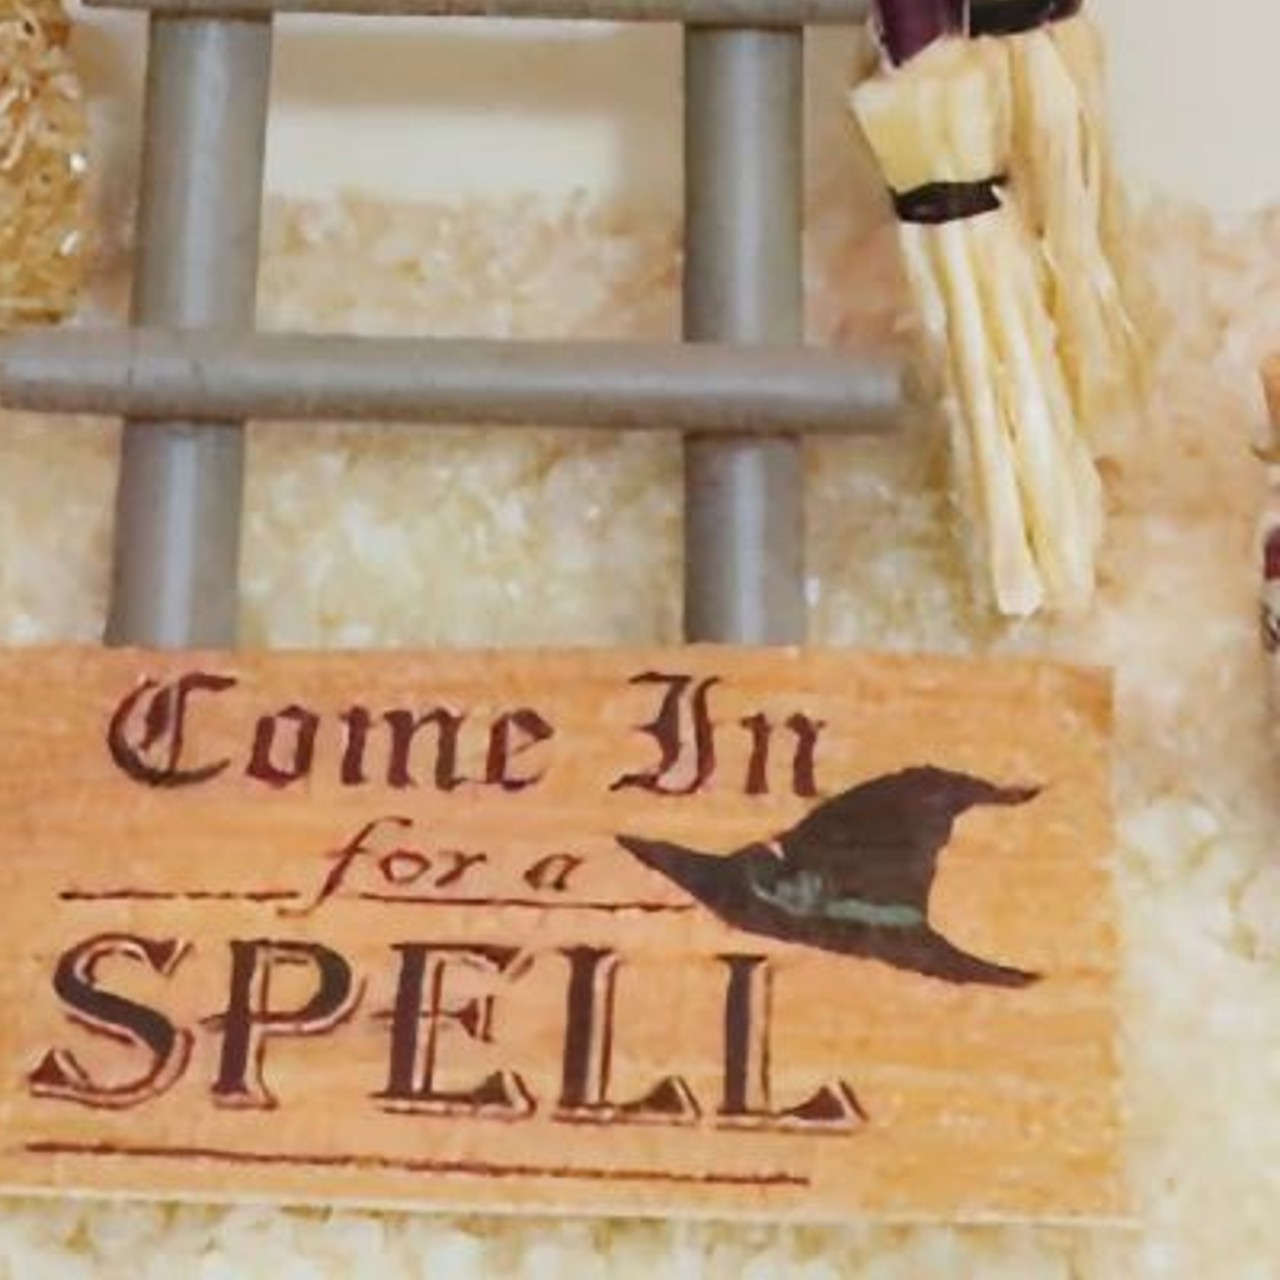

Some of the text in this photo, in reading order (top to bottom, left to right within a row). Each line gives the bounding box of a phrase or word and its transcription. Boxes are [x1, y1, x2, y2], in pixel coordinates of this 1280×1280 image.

[107, 670, 829, 799] Come In
[277, 816, 584, 918] for a
[26, 934, 868, 1132] SPELL
